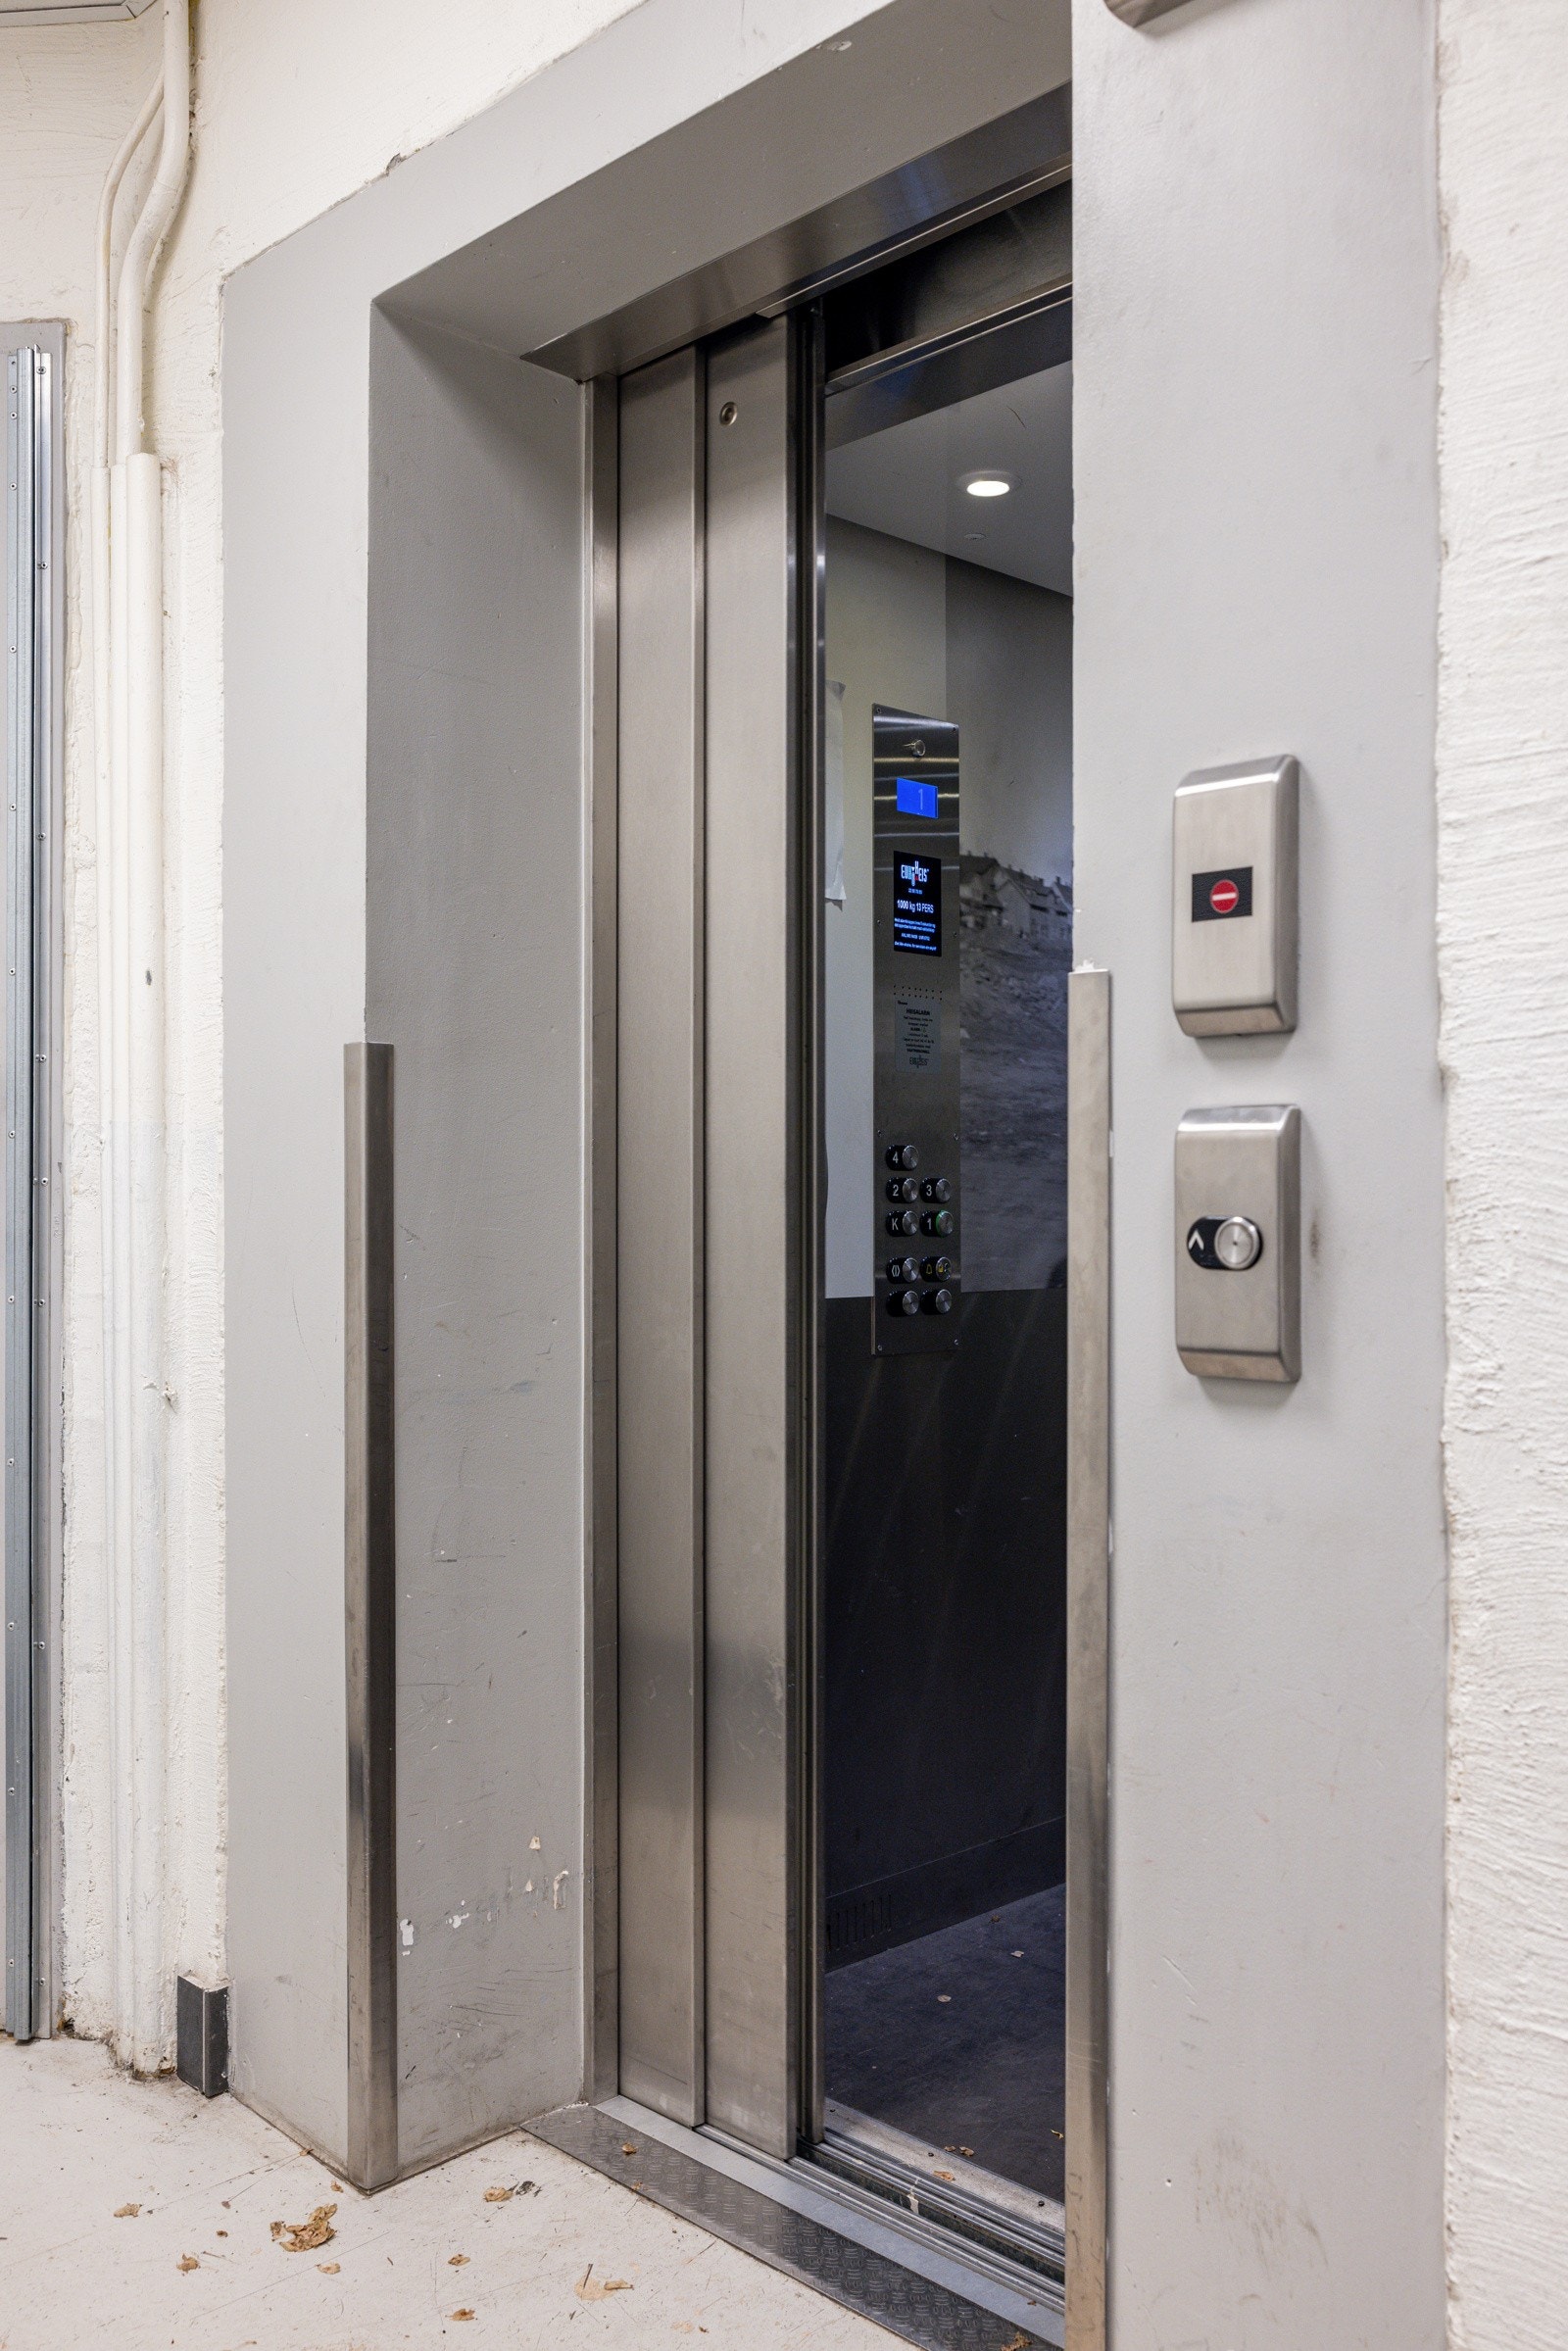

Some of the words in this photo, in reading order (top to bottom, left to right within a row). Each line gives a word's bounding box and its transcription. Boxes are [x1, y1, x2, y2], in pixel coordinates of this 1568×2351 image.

[892, 1151, 899, 1164] 4
[892, 1184, 900, 1197] 2
[926, 1184, 933, 1197] 3
[891, 1217, 899, 1231] K
[927, 1217, 933, 1230] 1
